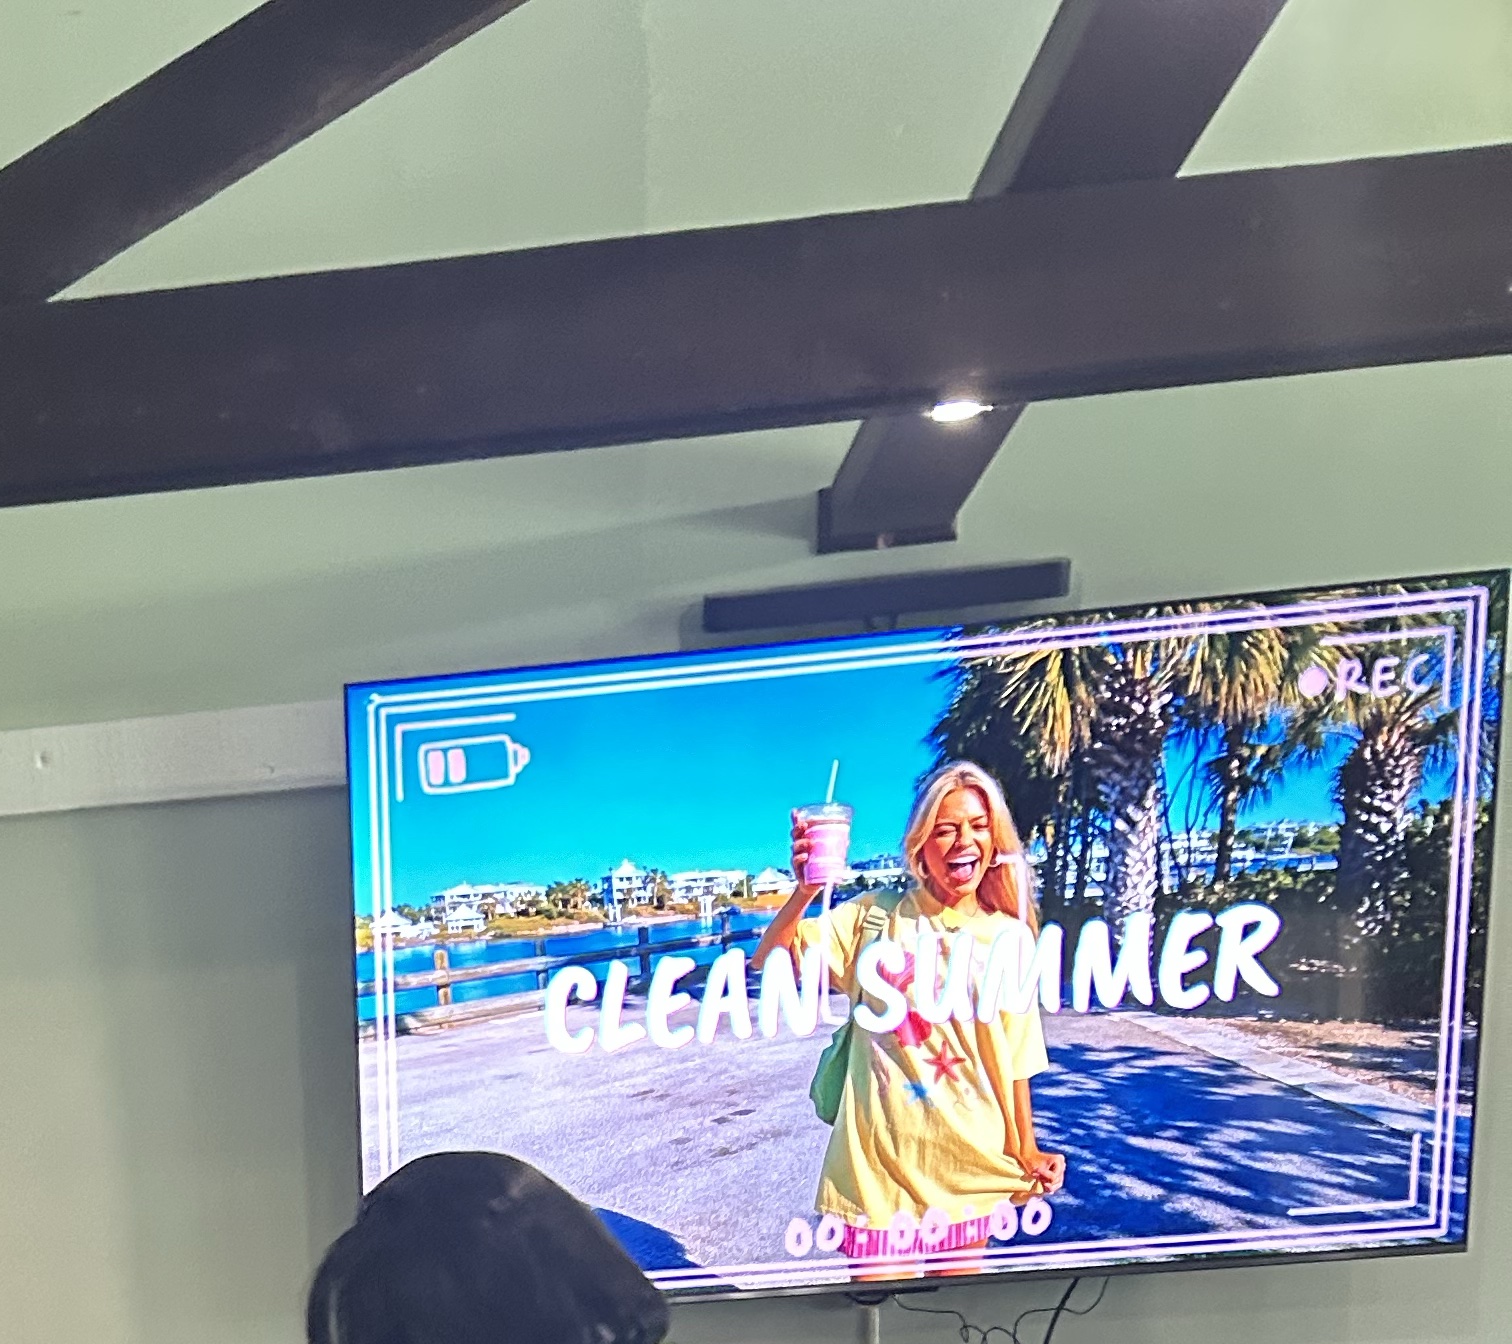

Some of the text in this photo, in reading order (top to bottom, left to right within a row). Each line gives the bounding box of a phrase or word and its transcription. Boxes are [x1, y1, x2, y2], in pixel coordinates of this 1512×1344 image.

[1336, 652, 1432, 702] REC
[543, 902, 1283, 1054] CLEAN SUMMER
